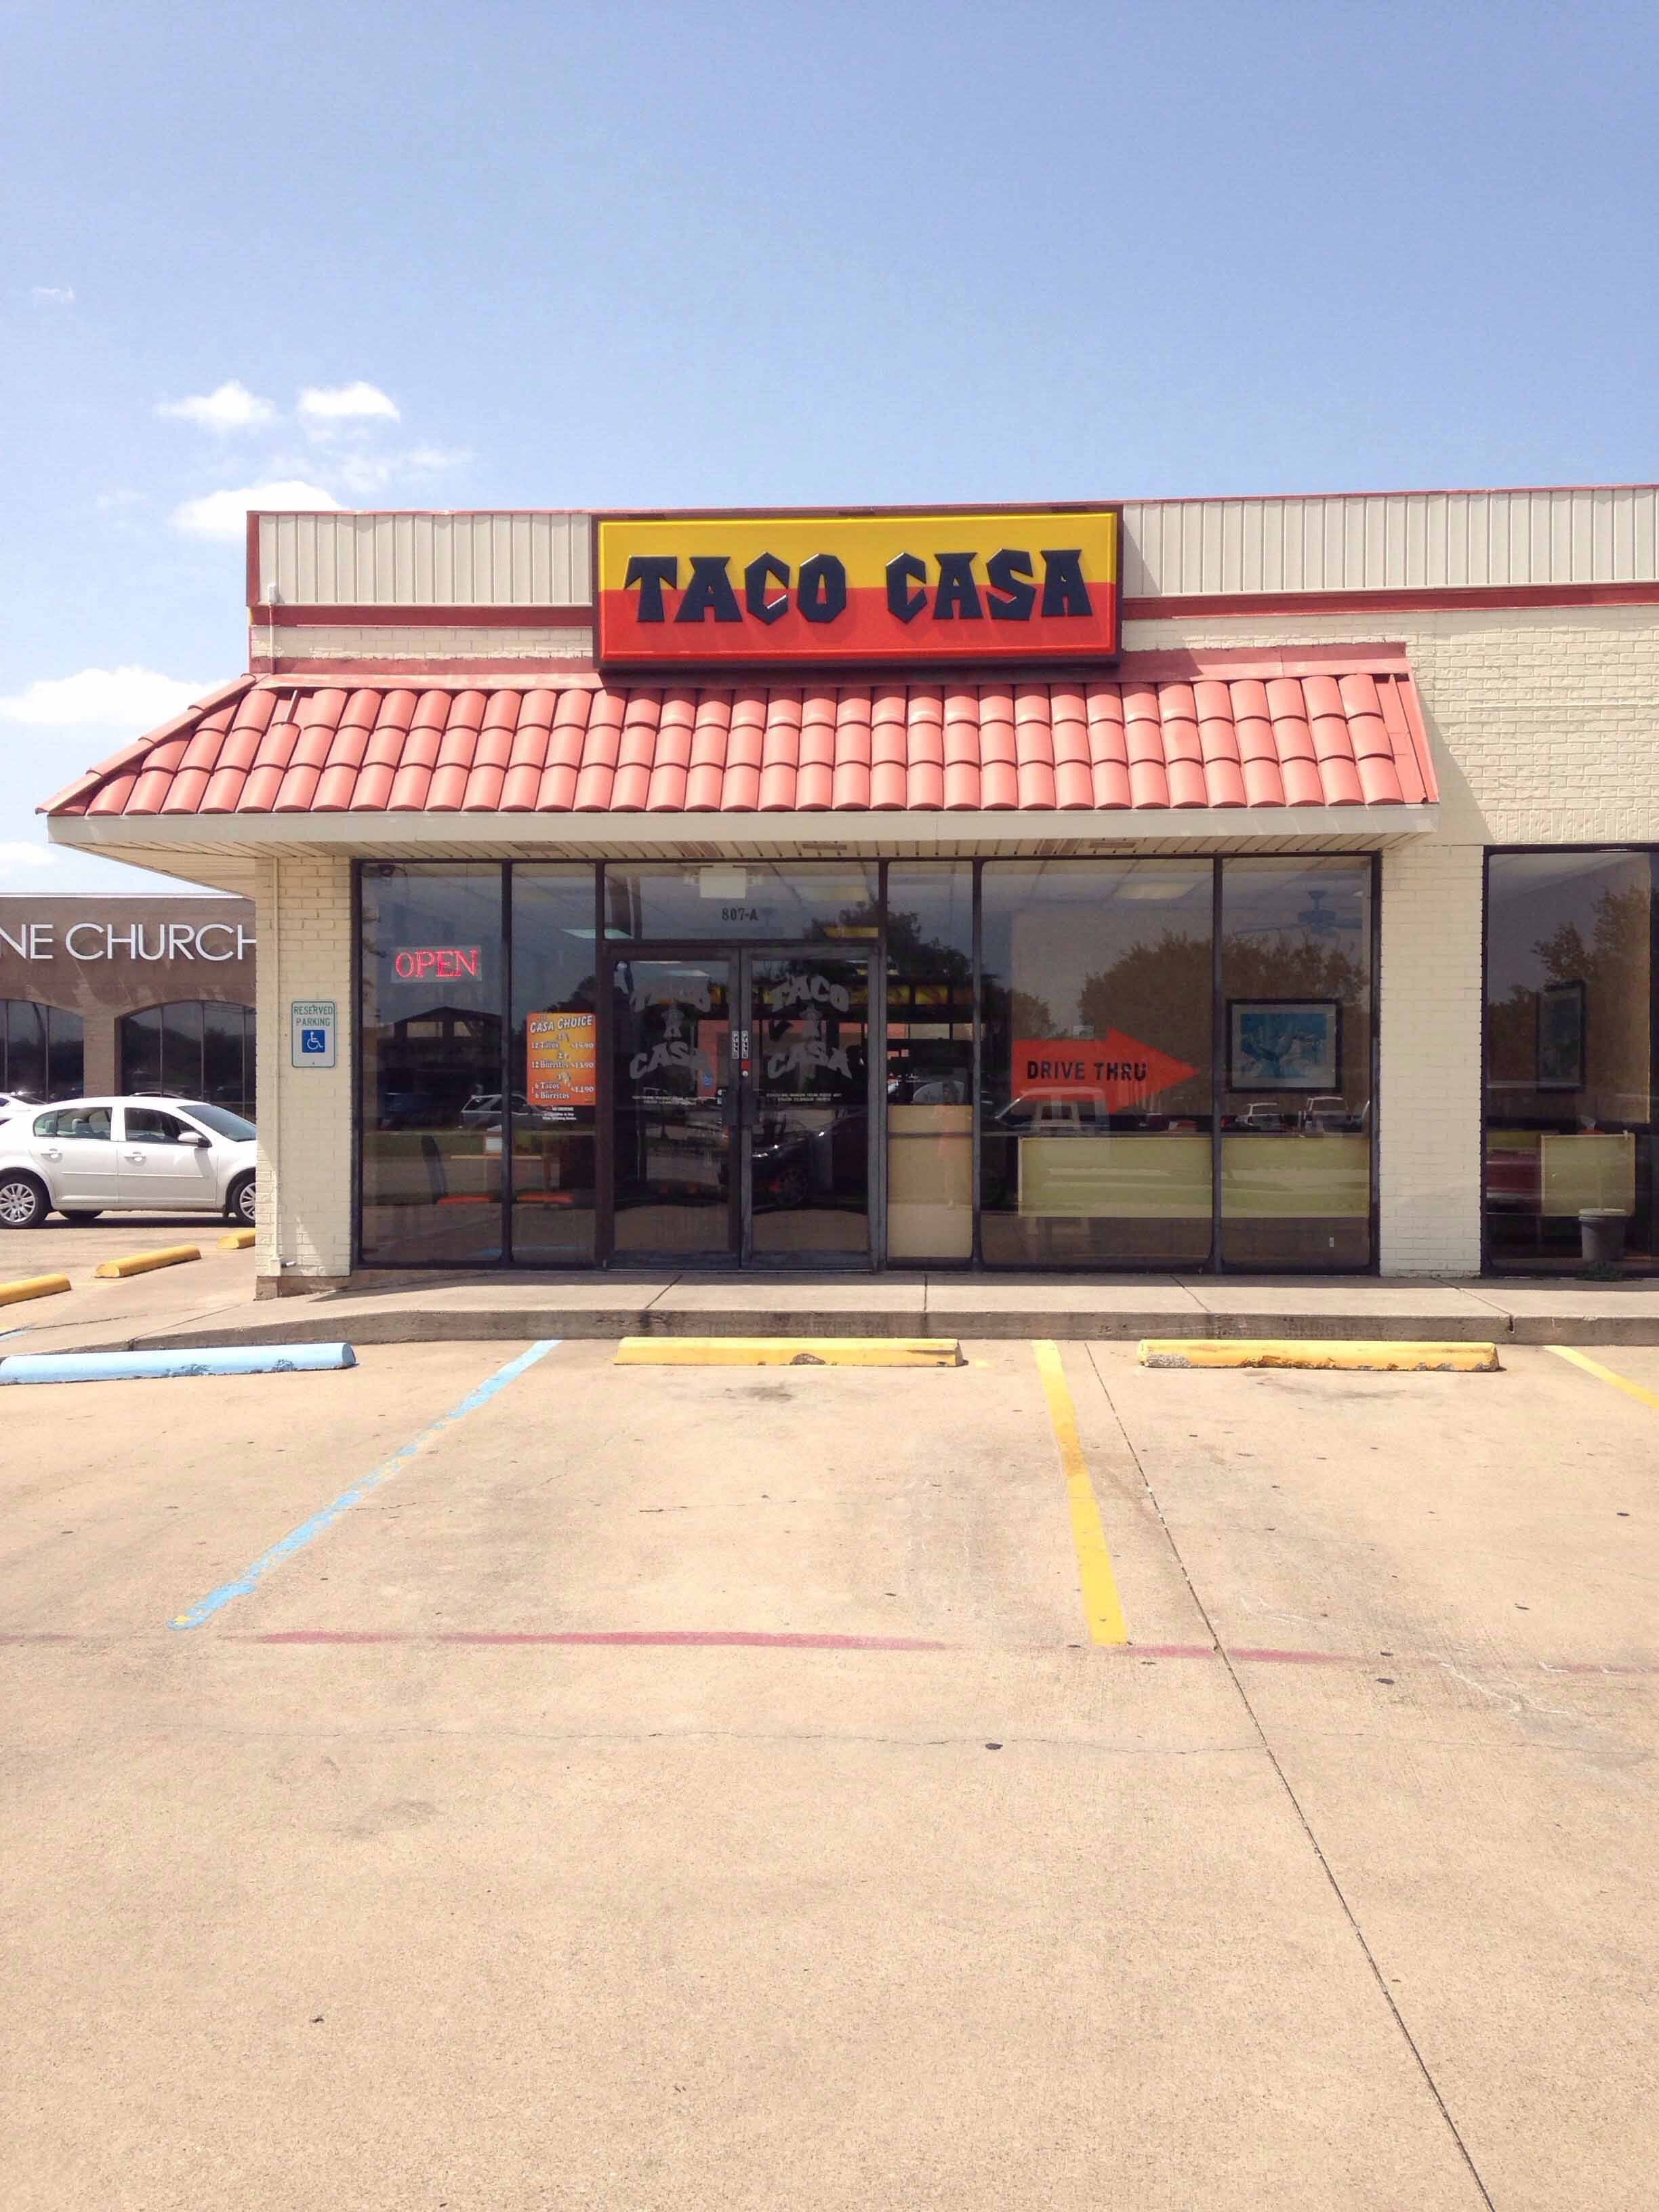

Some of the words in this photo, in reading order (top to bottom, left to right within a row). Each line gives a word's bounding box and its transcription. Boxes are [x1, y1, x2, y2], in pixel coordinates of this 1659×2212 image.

[623, 551, 846, 625] TACO
[885, 548, 1092, 624] CASA
[721, 907, 759, 921] 807-A
[66, 922, 257, 961] CHURCH
[395, 949, 478, 977] OPEN
[630, 975, 712, 1013] TO
[769, 974, 850, 1012] TACO
[293, 1006, 333, 1015] RESERVED
[296, 1018, 330, 1026] PARKING
[530, 1021, 554, 1033] CASA
[557, 1015, 593, 1029] CHOICE
[767, 1040, 853, 1079] CASA
[1027, 1061, 1085, 1080] DRIVE
[1094, 1061, 1147, 1082] THRU
